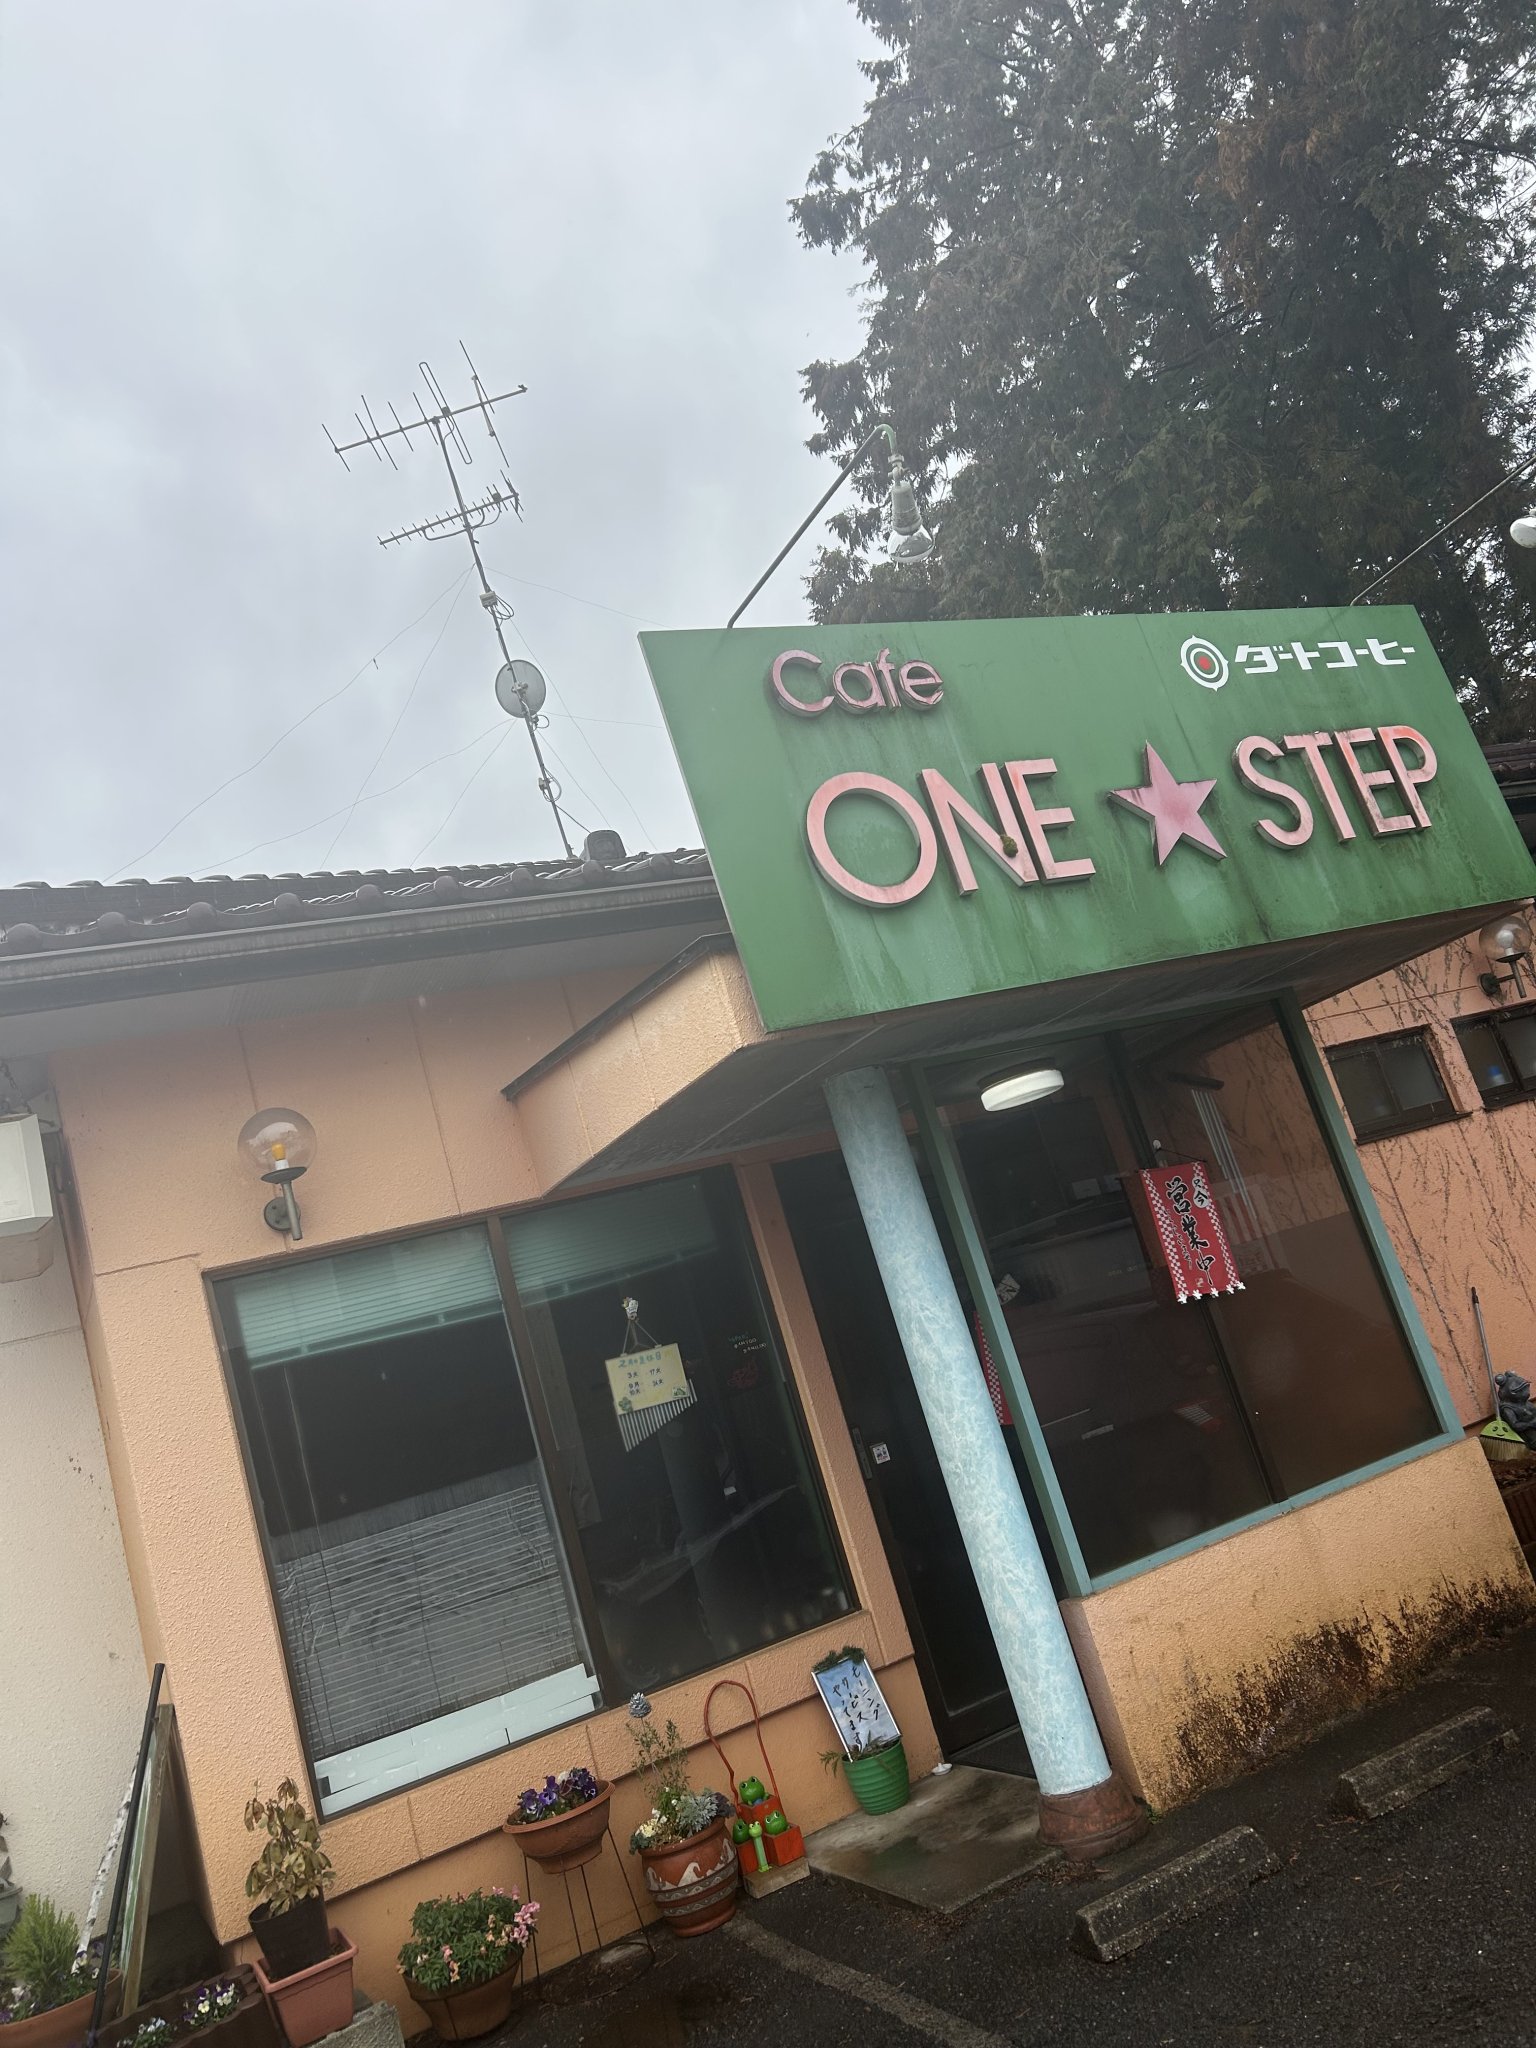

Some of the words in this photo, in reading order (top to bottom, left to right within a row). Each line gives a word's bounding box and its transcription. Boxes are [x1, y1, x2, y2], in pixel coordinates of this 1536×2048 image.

[771, 648, 945, 716] Cafe
[1234, 638, 1416, 675] ダートコーヒー
[806, 758, 1097, 907] ONE
[1233, 725, 1438, 848] STEP
[1165, 1175, 1216, 1286] 営業中
